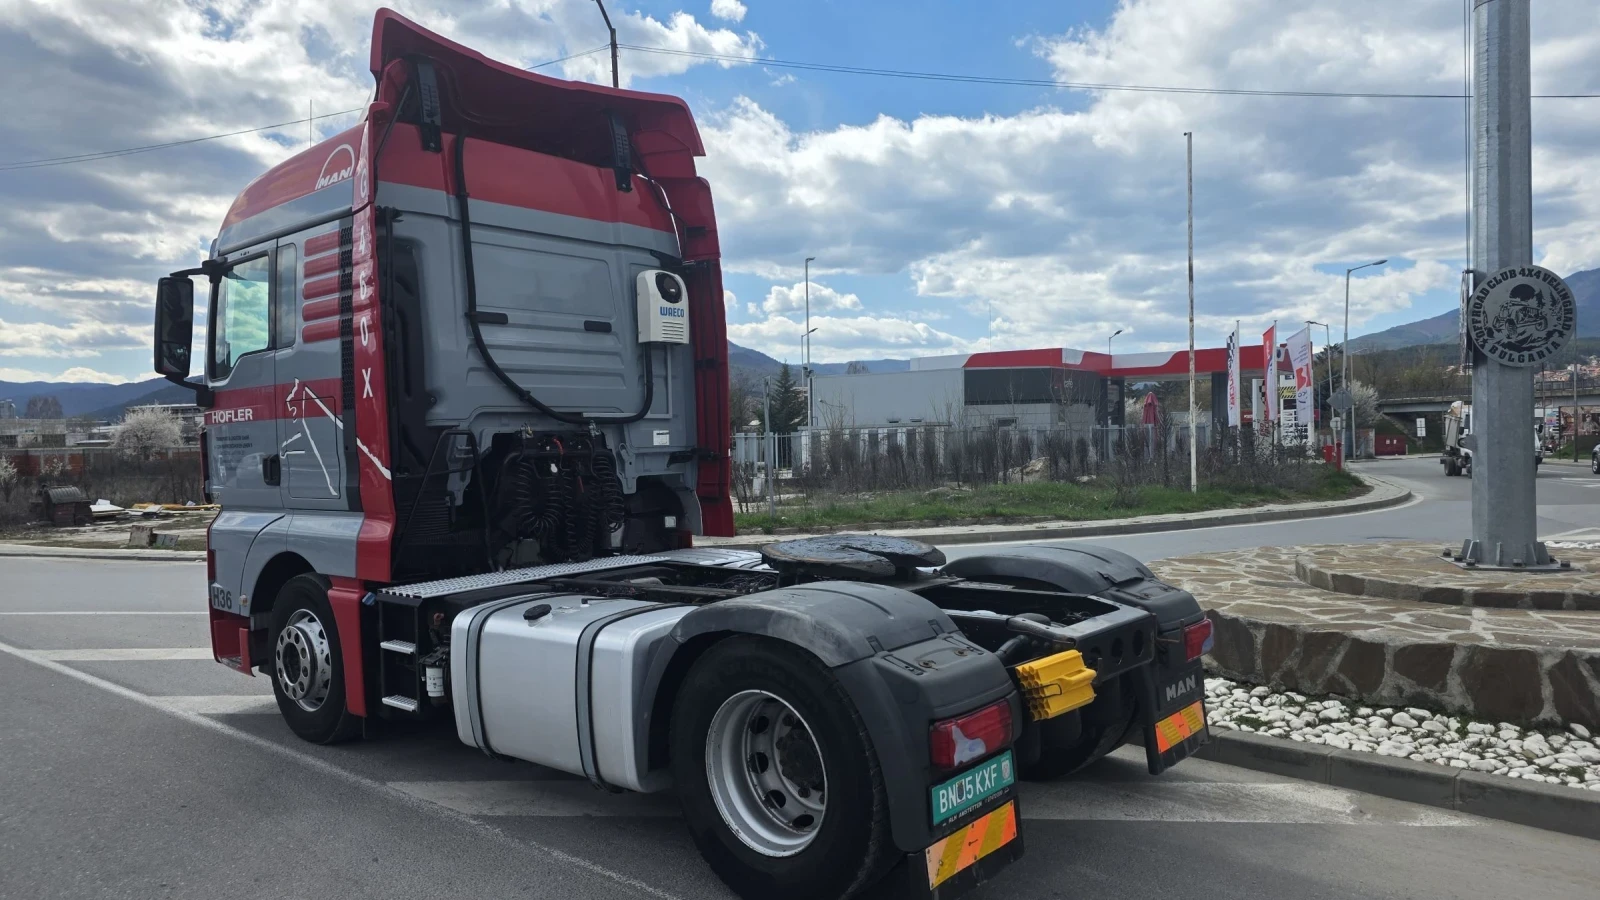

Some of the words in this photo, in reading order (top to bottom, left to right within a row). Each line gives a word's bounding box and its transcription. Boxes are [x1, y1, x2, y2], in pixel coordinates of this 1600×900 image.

[317, 166, 351, 190] MAN
[660, 306, 685, 318] WAECO
[1472, 287, 1490, 340] OFFROAD
[1487, 268, 1517, 289] CLUB
[1519, 267, 1542, 280] 4X4
[1542, 273, 1573, 331] VELINGRAD
[1488, 341, 1561, 363] BULGARIA
[212, 586, 232, 610] H36
[1166, 674, 1196, 702] MAN
